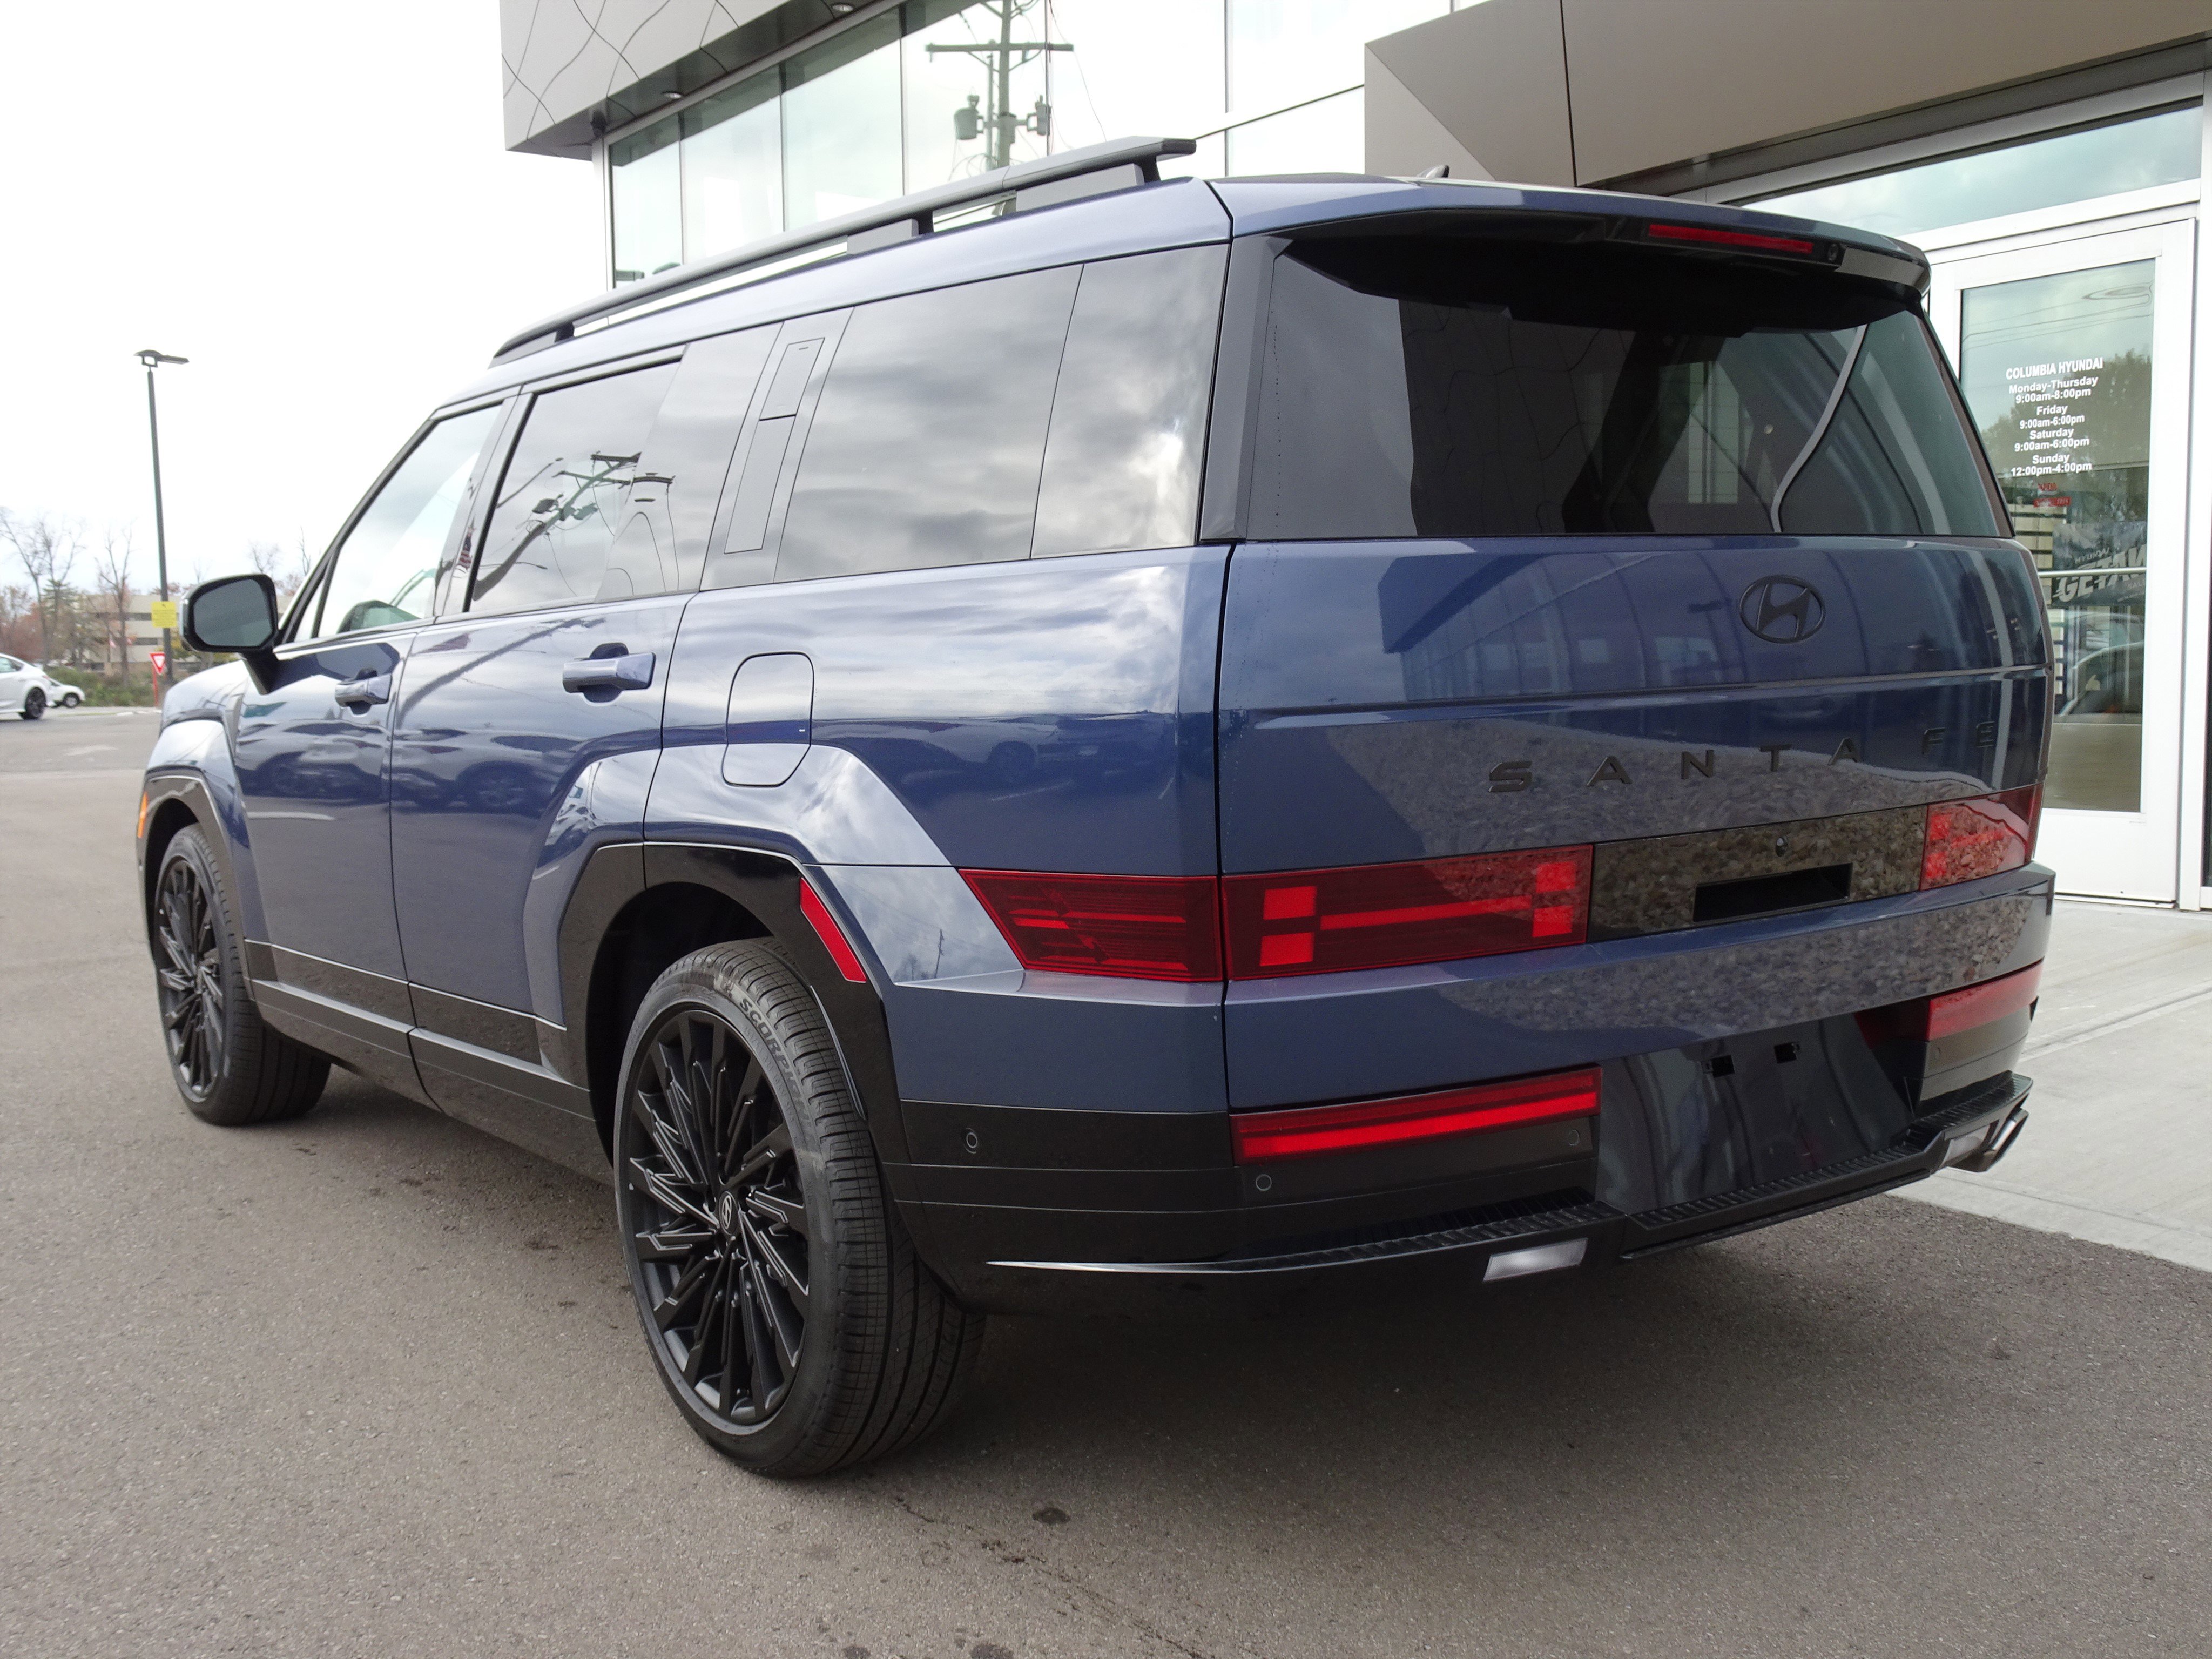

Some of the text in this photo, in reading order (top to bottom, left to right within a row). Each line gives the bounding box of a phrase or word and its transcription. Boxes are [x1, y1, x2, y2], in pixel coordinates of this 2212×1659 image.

[2006, 357, 2103, 380] COLUMBIA HYUNDAI
[2009, 376, 2099, 394] Monday-Thursday
[2015, 388, 2092, 404] 9:00am-8:00pm
[2036, 405, 2068, 416] Friday
[2020, 415, 2085, 429] 9:00am-6:00pm
[2029, 428, 2074, 440] Saturday
[2014, 438, 2090, 452] 9:00am-6:00pm
[2032, 454, 2071, 464] Sunday
[2011, 463, 2092, 476] 12:00pm-4:00pm
[1488, 720, 1995, 793] SANTA FE
